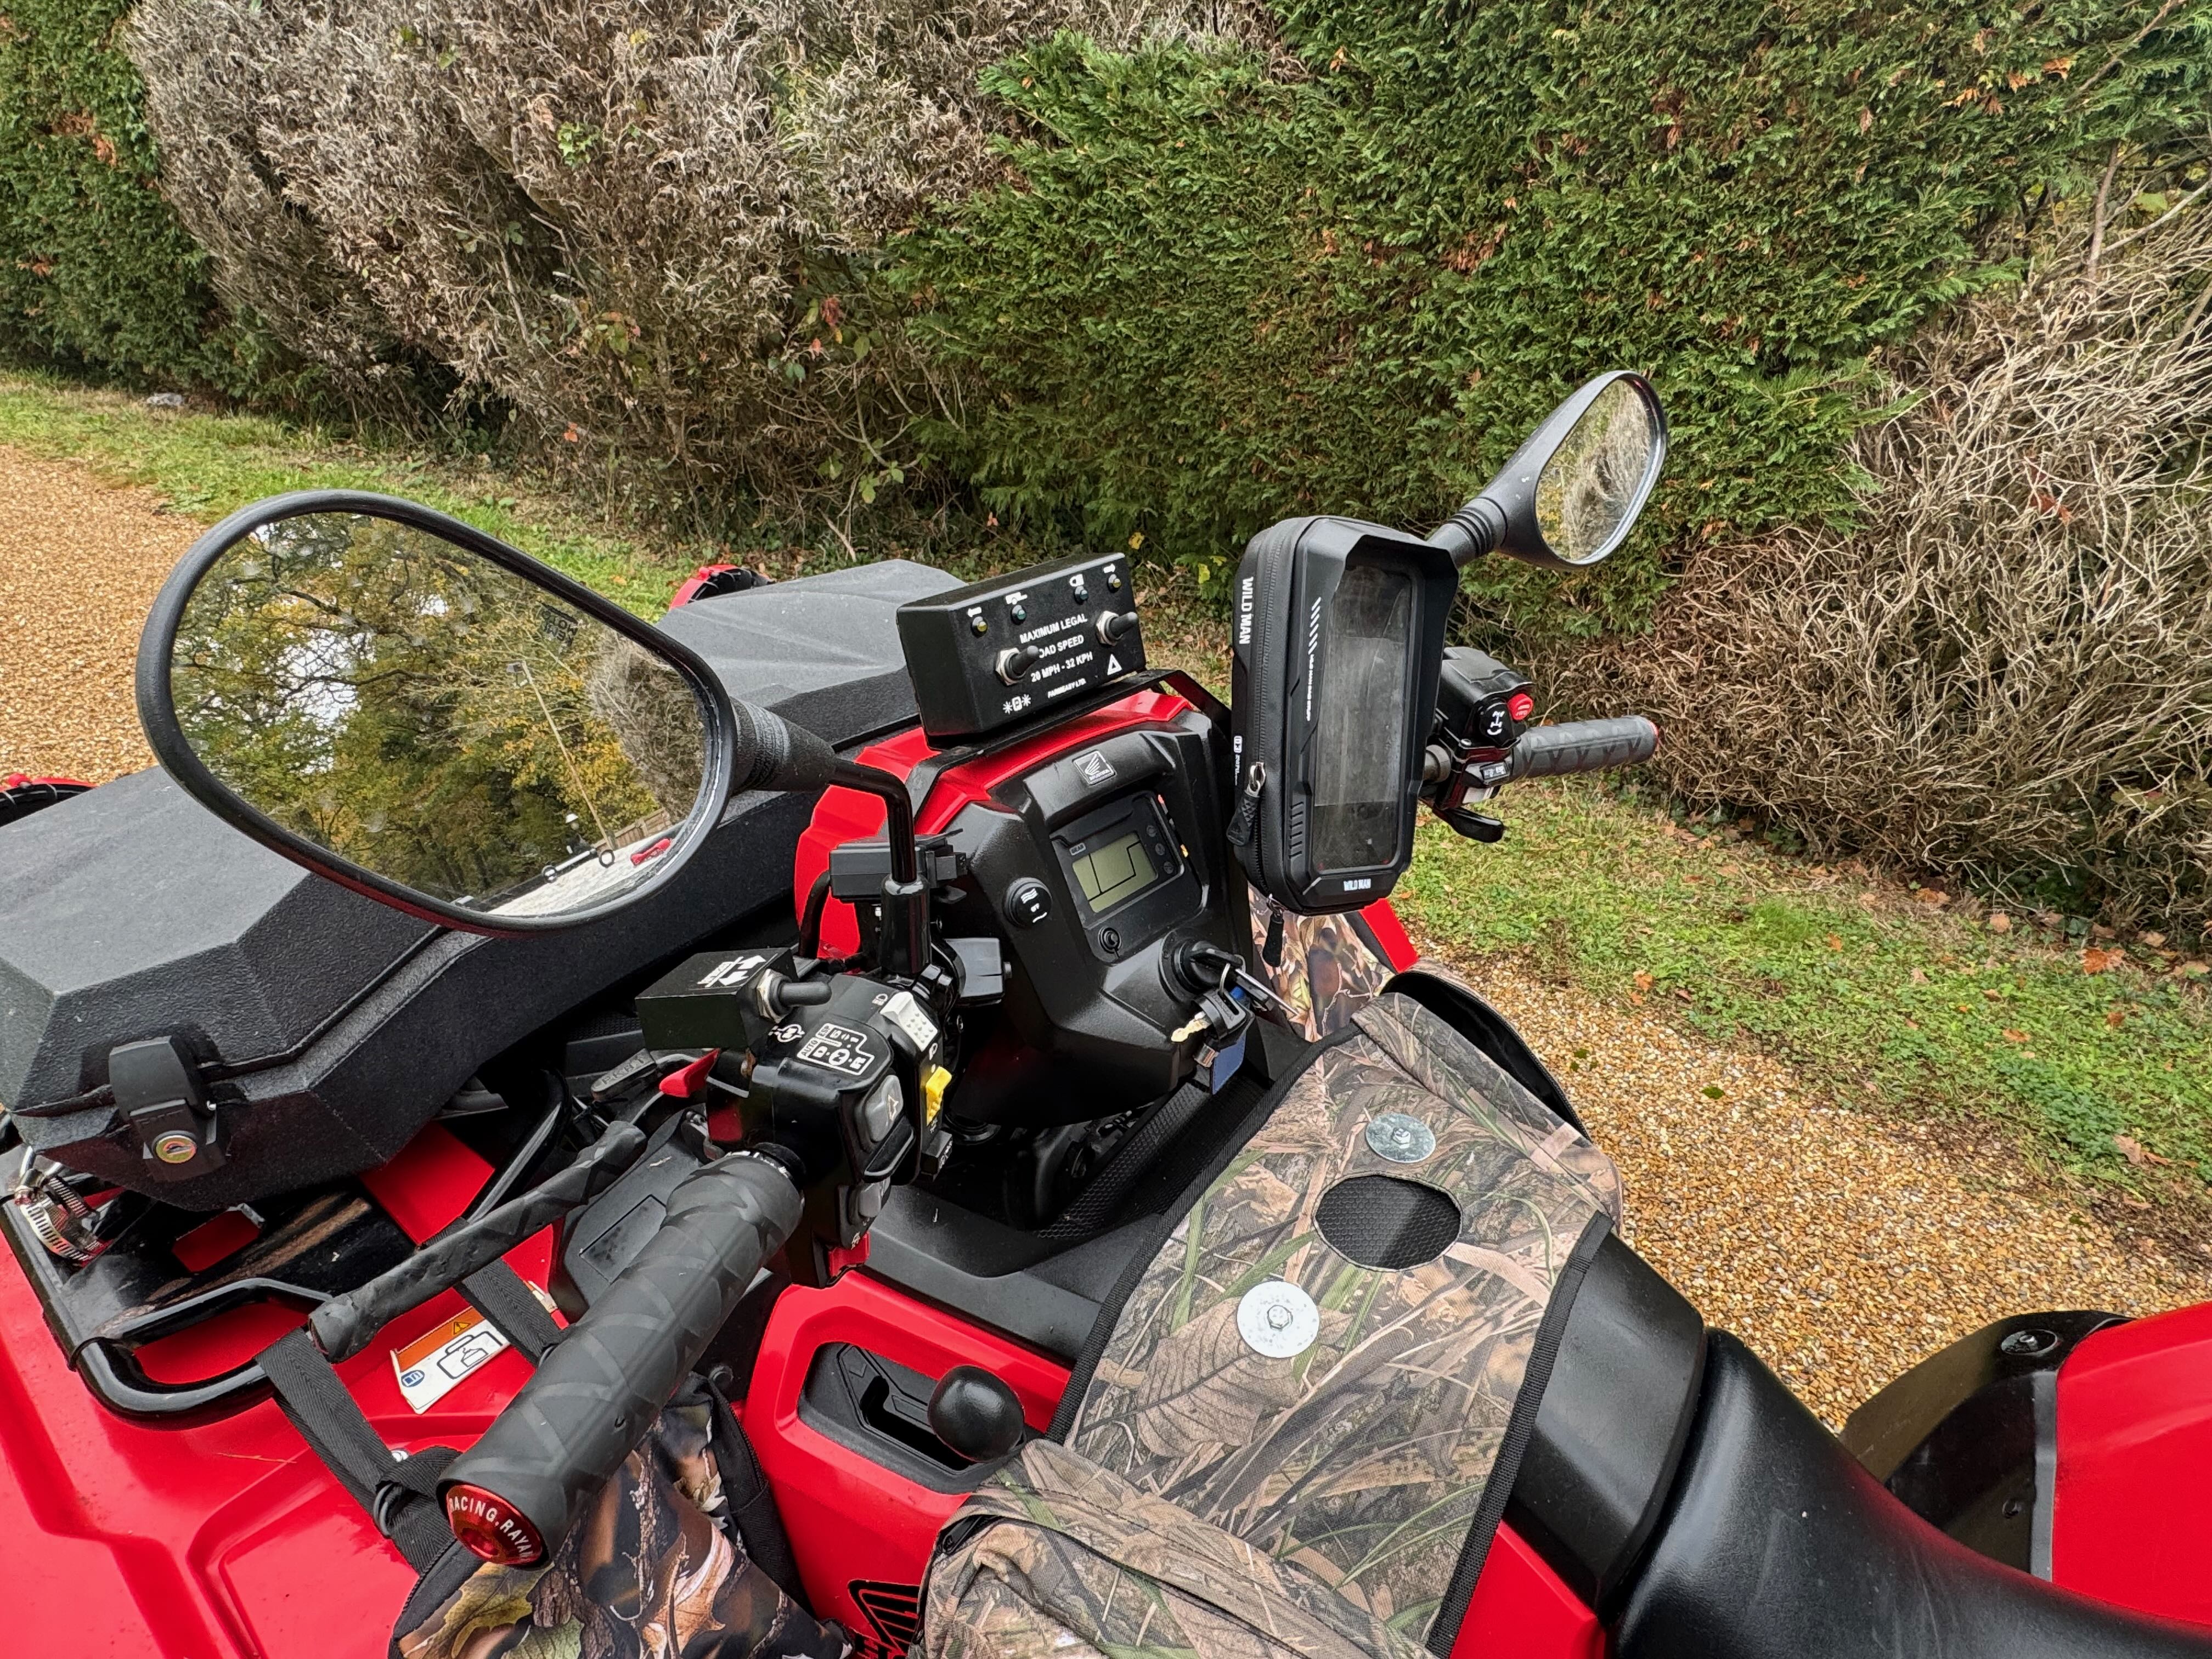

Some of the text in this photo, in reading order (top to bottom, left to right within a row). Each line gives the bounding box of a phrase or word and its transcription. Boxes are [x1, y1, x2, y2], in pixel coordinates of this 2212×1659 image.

[1239, 576, 1254, 645] WILD MAN
[1019, 613, 1088, 644] MAXIMUM LEGAL
[1039, 634, 1085, 659] OAD SPEED
[1030, 670, 1041, 682] 20
[1041, 663, 1061, 679] MPH
[1065, 658, 1076, 669] 32
[1075, 651, 1093, 665] KPH
[817, 1025, 830, 1037] ESP
[800, 1039, 819, 1057] AUTO
